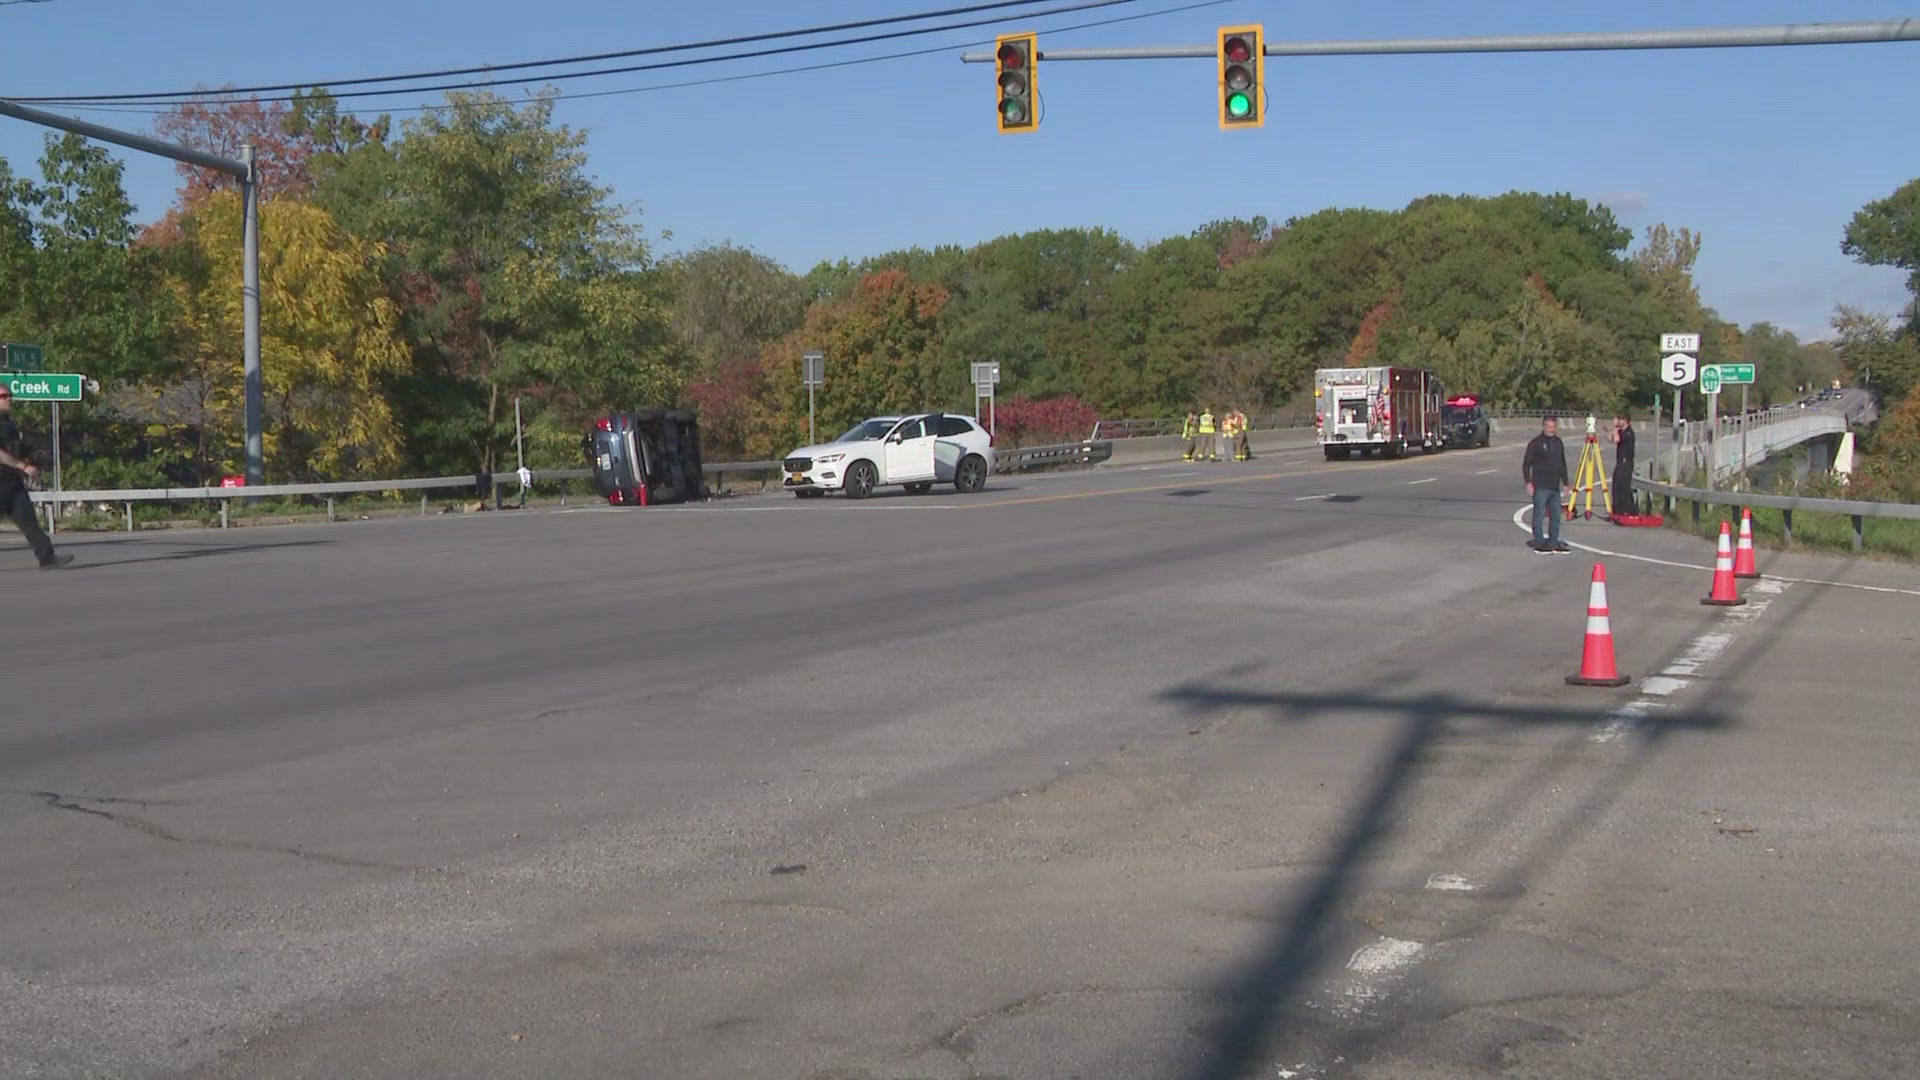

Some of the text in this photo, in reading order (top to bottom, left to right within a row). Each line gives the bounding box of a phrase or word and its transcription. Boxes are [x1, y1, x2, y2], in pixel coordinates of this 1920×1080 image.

[1667, 337, 1692, 348] EAST
[1673, 362, 1686, 380] 5
[10, 380, 70, 394] Creek Rd
